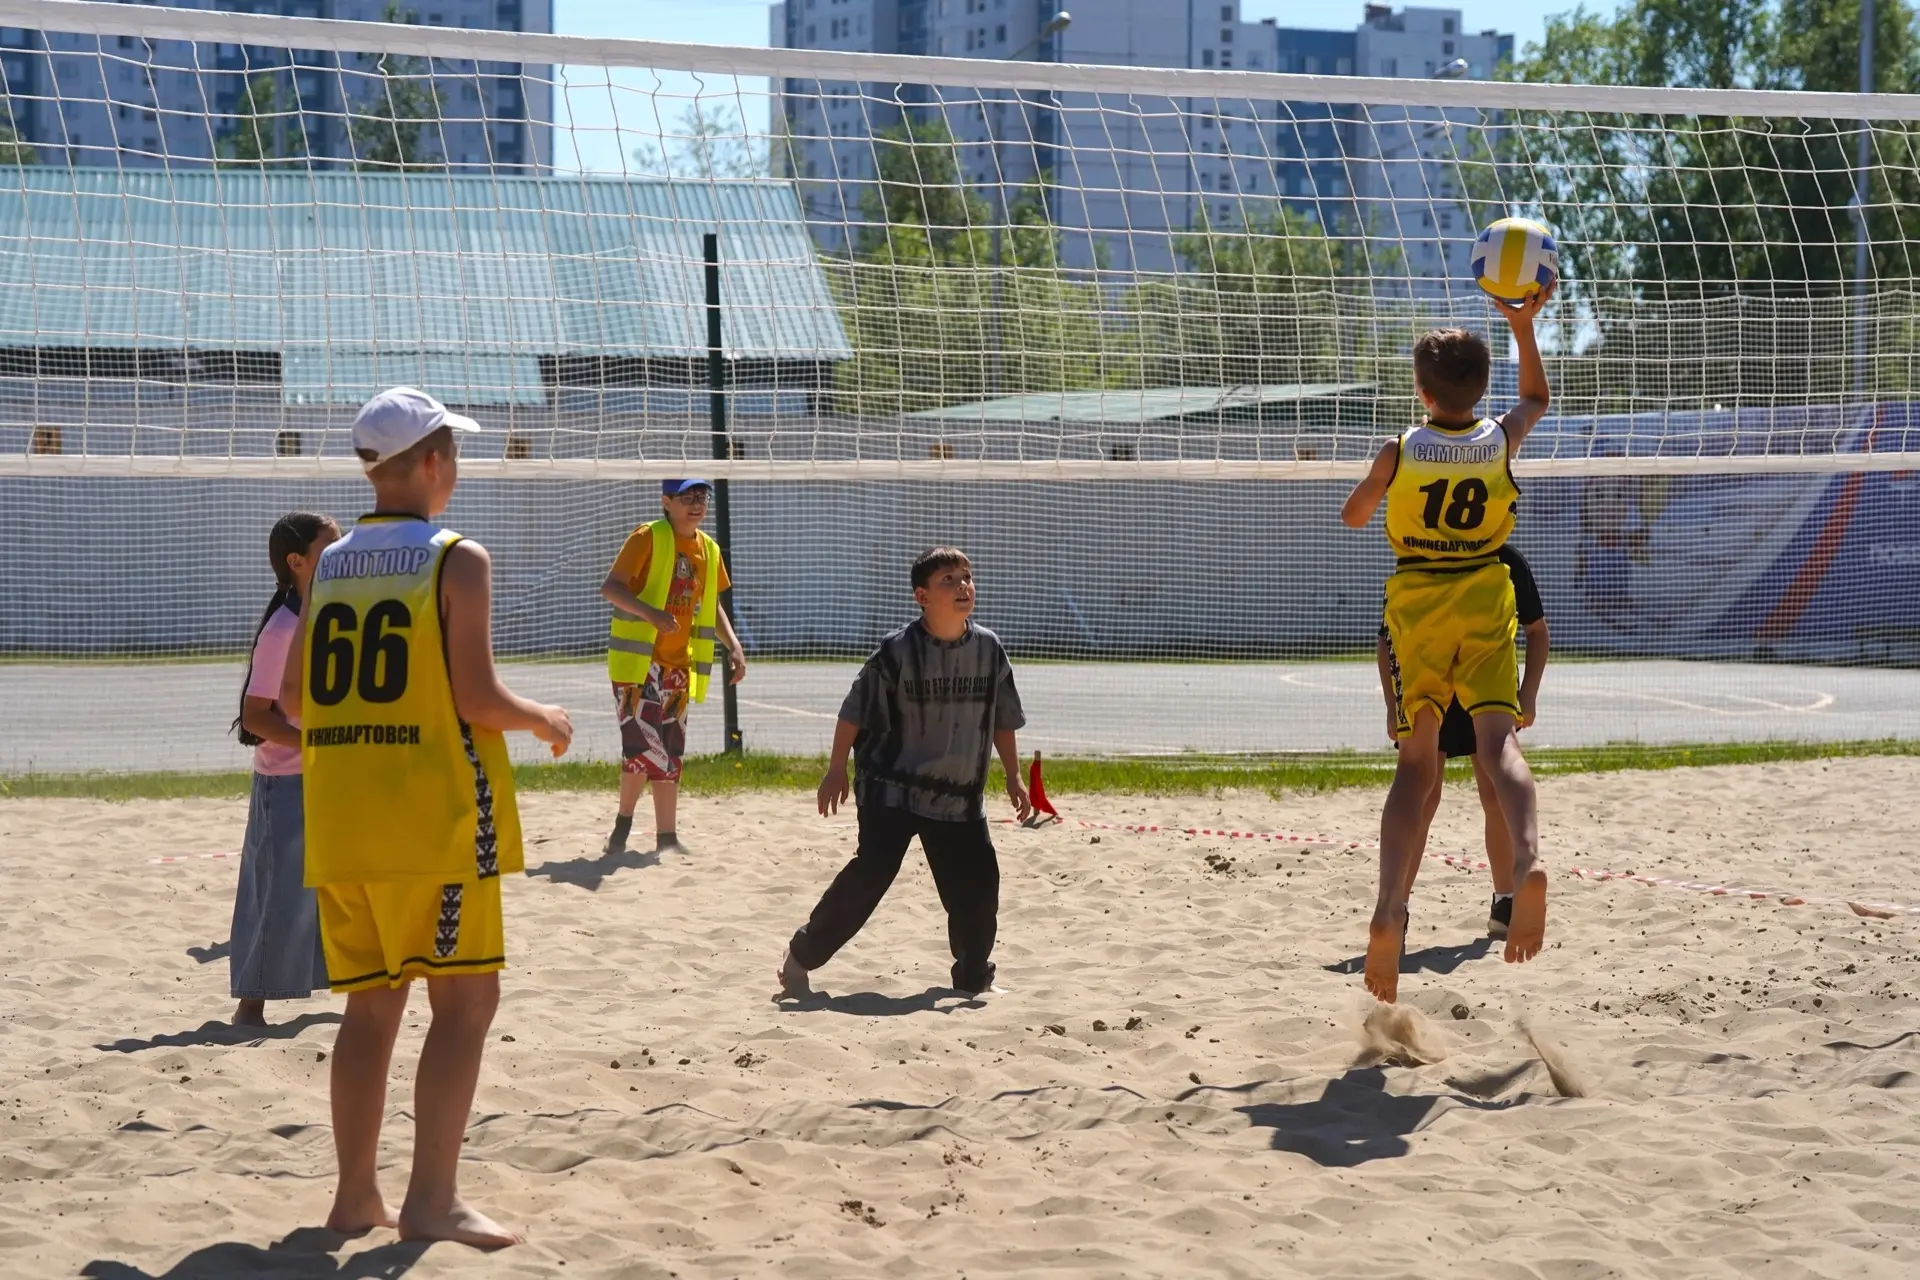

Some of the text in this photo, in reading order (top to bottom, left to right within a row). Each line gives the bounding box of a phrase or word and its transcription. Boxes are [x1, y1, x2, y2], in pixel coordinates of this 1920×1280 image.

[1413, 442, 1499, 464] САМОТЛОР
[1419, 477, 1489, 530] 18
[317, 546, 429, 582] САМОТЛОР
[309, 599, 412, 706] 66
